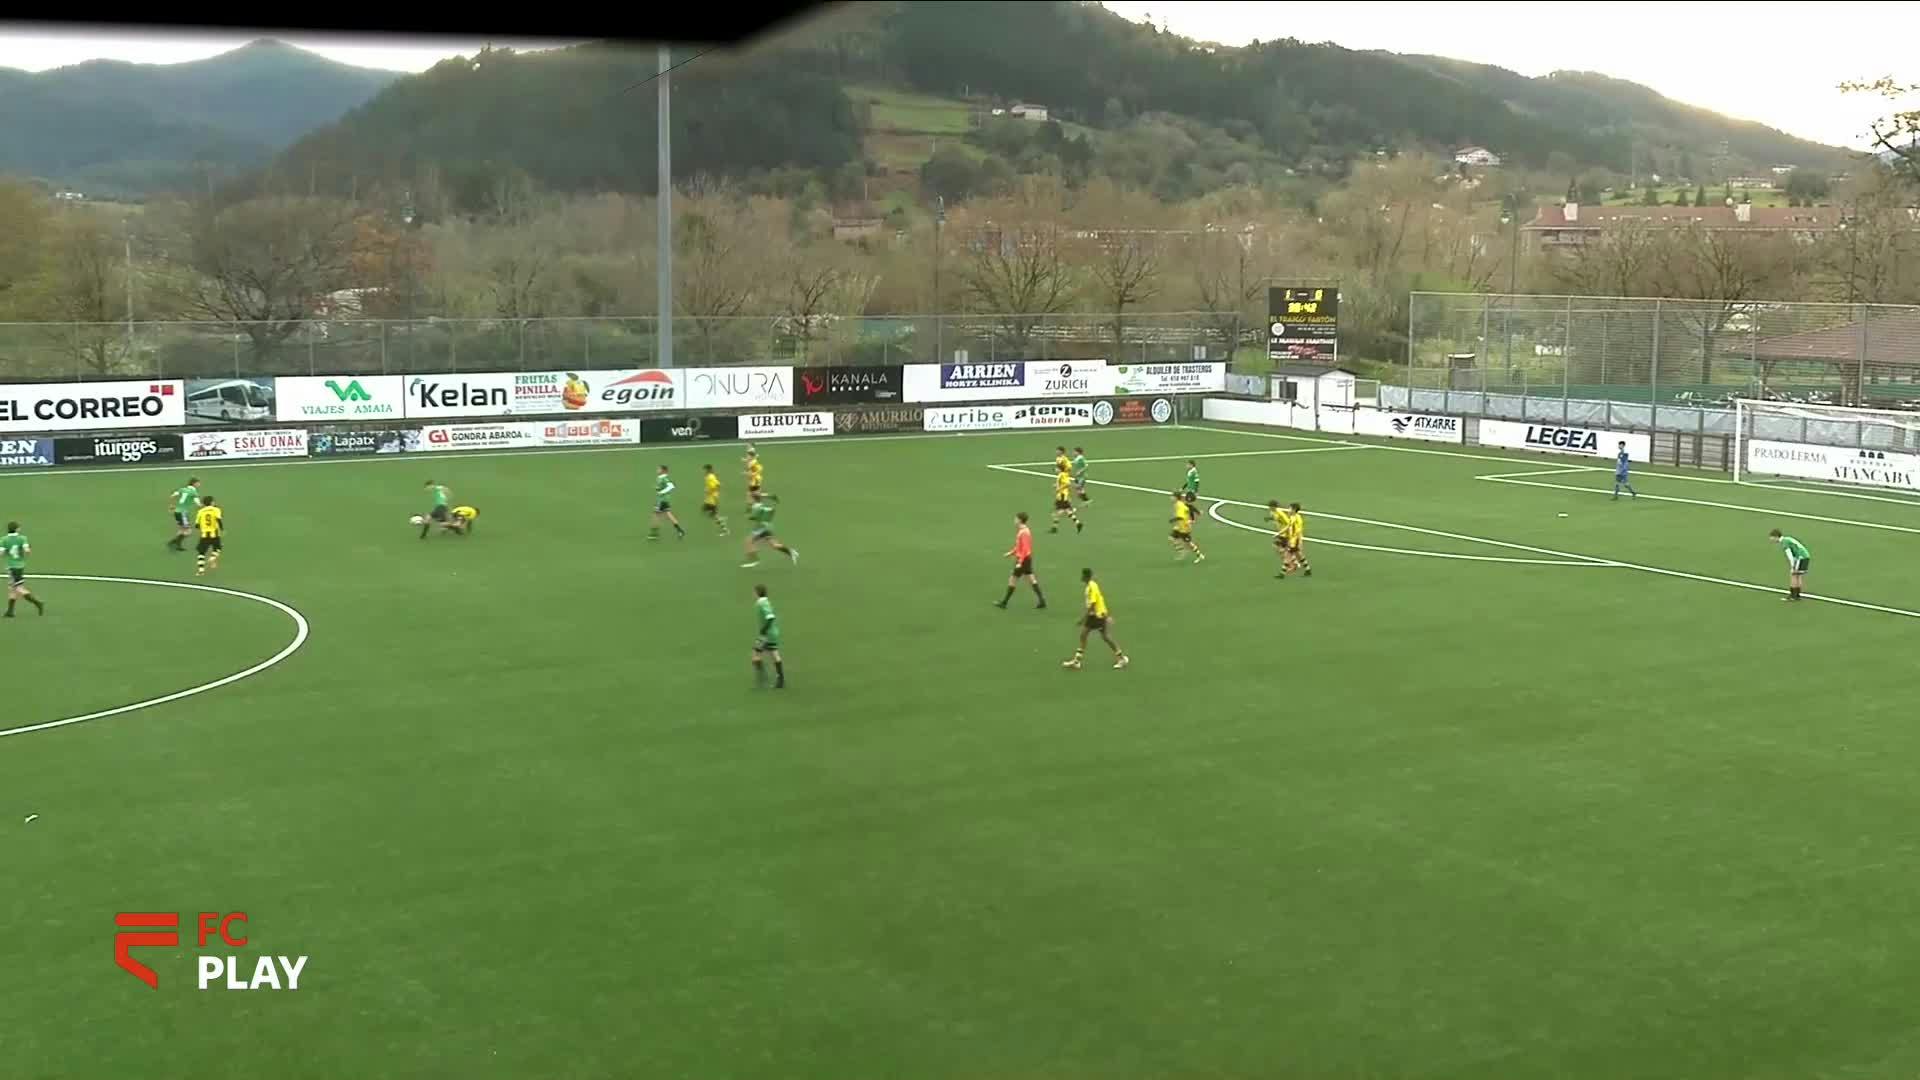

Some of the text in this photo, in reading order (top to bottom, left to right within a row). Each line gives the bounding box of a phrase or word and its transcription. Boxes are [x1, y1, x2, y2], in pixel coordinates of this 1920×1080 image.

[949, 363, 1016, 379] ARRIEN
[1146, 364, 1212, 375] ALQUILER DE TRASTEROS
[515, 375, 558, 384] FRUTAS
[831, 373, 888, 384] KANALA
[980, 378, 1020, 386] KLINIKA
[1045, 379, 1088, 390] ZURICH
[421, 382, 507, 408] Kelan
[601, 384, 674, 404] egoin
[34, 396, 163, 420] CORREO
[301, 404, 393, 415] VIAJES AMAIA
[1015, 406, 1089, 419] aterpe
[751, 414, 822, 427] URRUTIA
[860, 409, 922, 423] AMURRIO
[942, 409, 1004, 423] uribe
[1414, 417, 1456, 431] ATXARRE
[234, 435, 302, 449] ESKU ONAK
[335, 436, 375, 449] Lapatx
[452, 432, 487, 441] GONDRA
[489, 431, 522, 439] ABAROA
[1525, 426, 1598, 450] LEGEA
[1755, 447, 1827, 464] PRADO LERMA
[1832, 466, 1911, 485] ATANCABA
